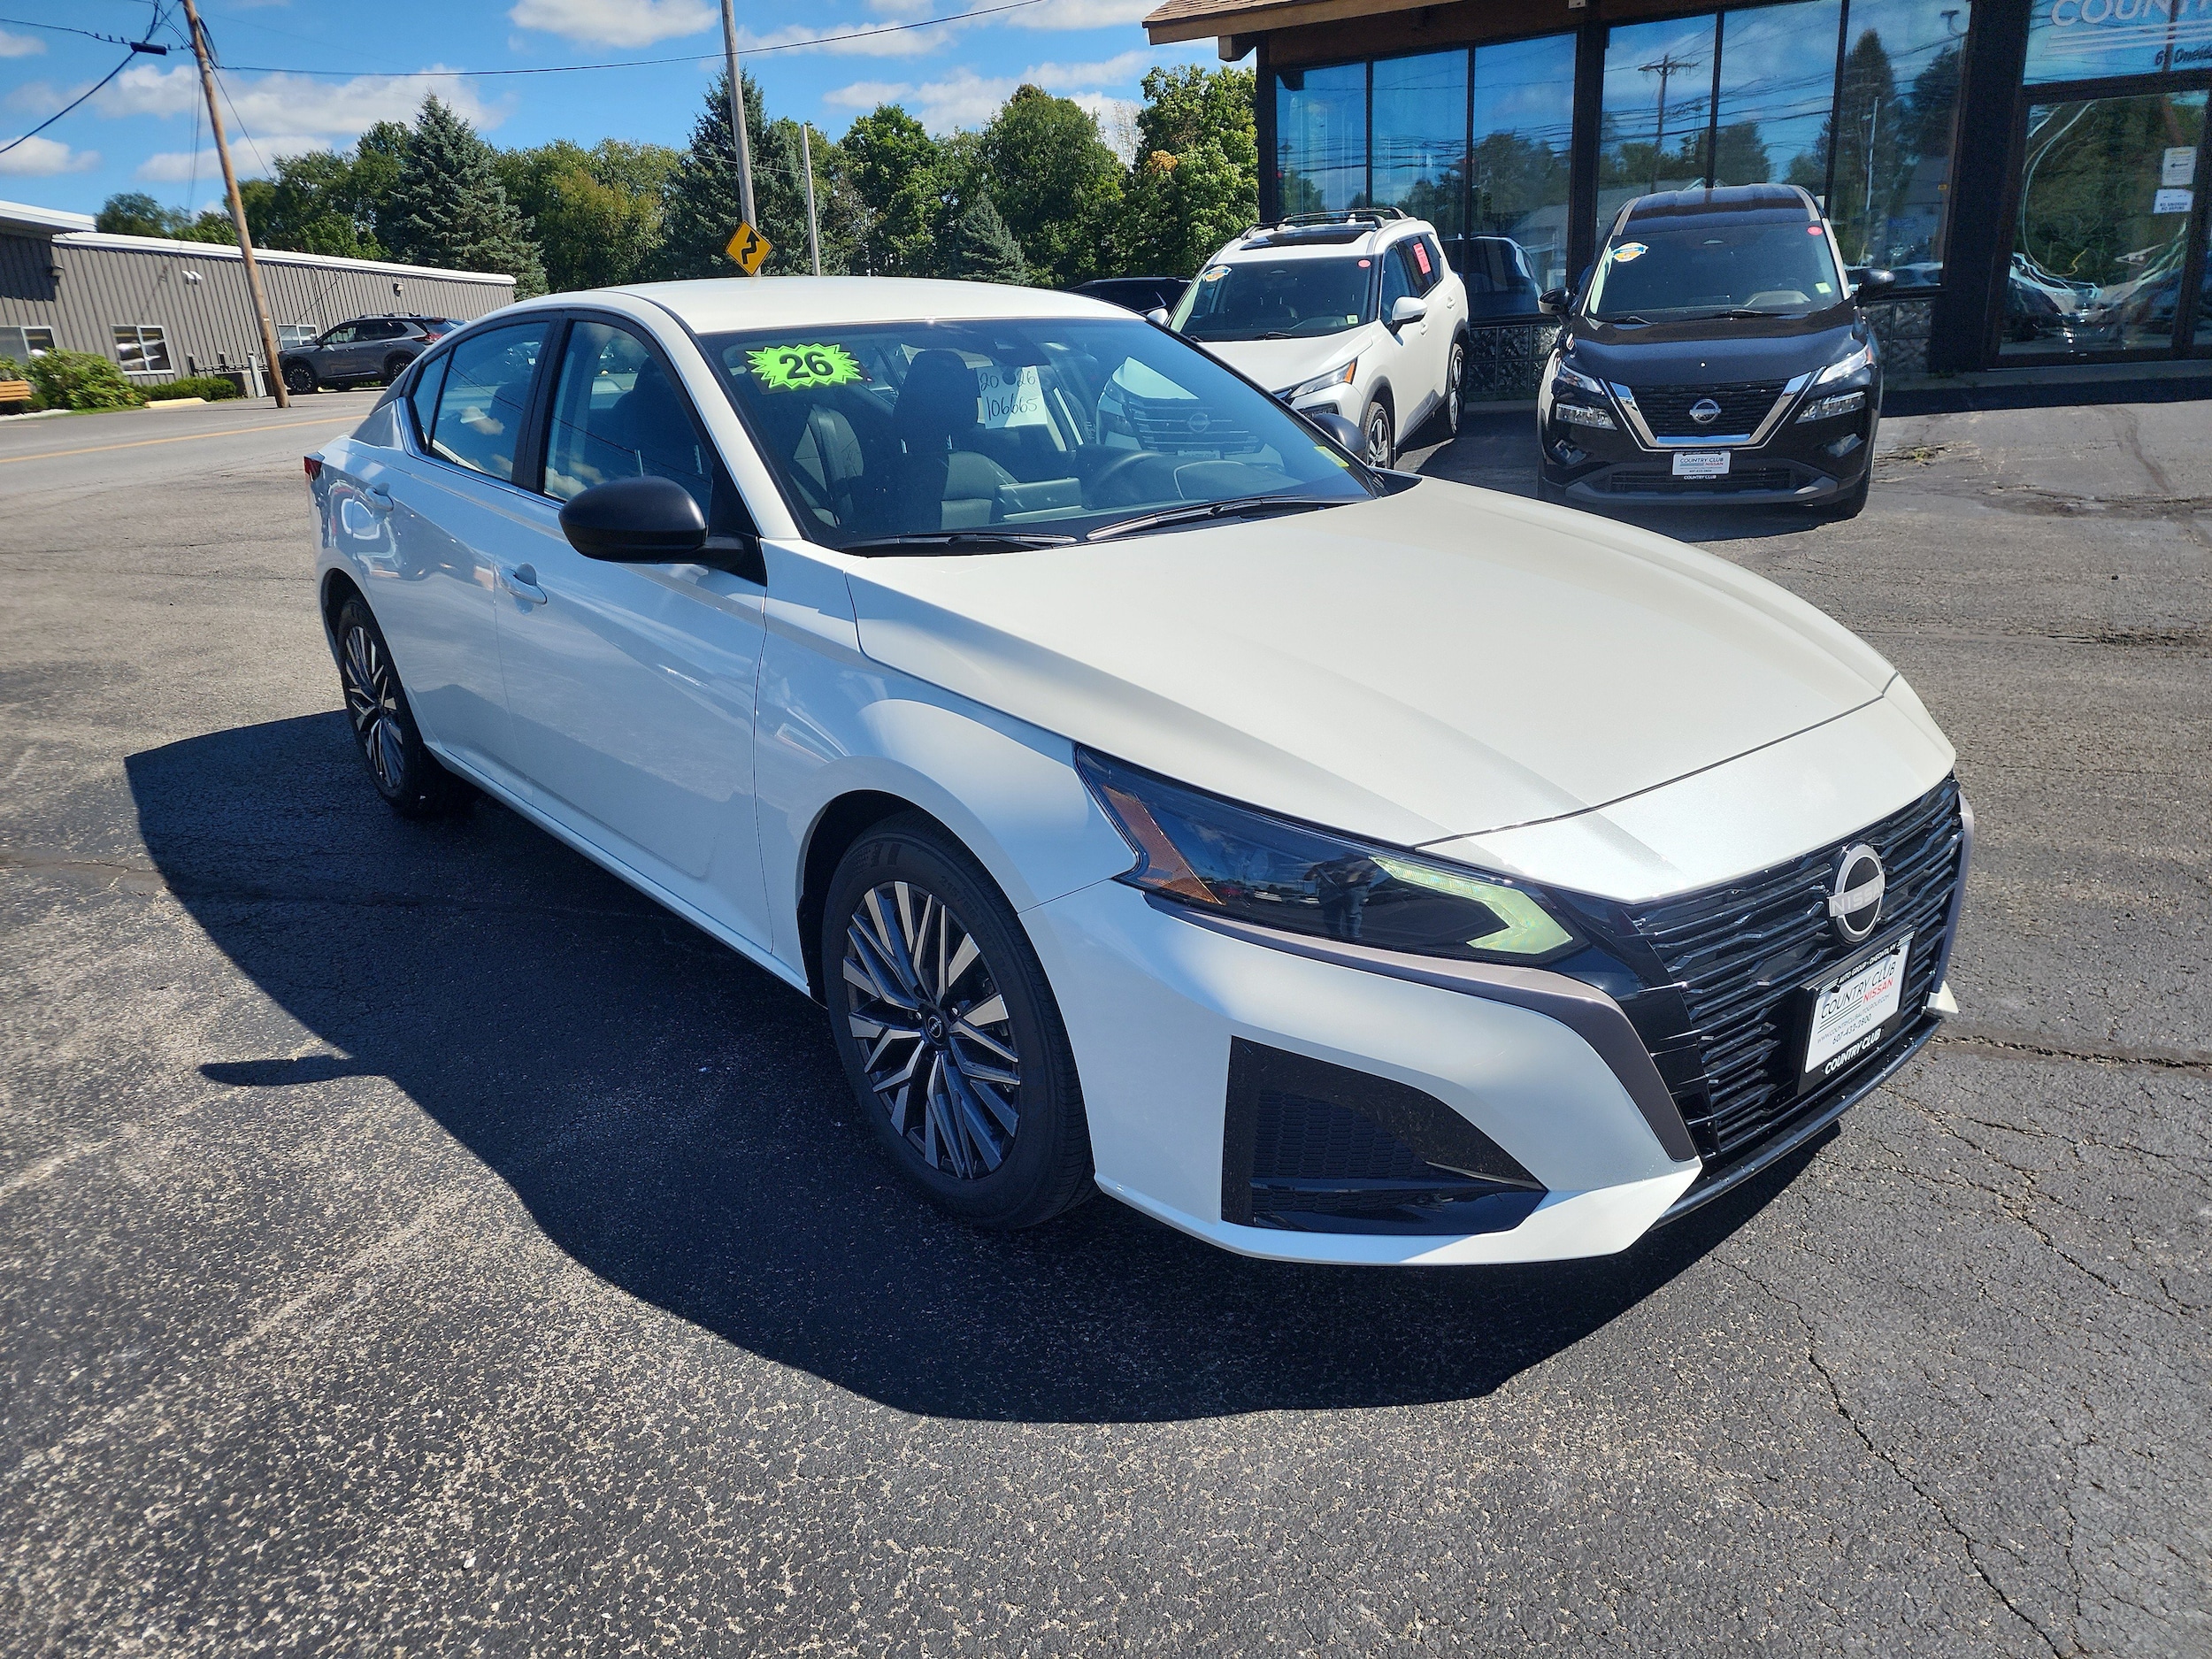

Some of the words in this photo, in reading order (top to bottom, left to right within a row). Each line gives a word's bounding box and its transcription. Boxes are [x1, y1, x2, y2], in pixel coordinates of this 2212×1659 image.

[779, 350, 833, 380] 26
[987, 394, 1038, 421] 106665
[1821, 977, 1870, 1019] COUNTRY
[1871, 961, 1896, 985] CLUB
[1863, 977, 1893, 1004] NISSAN
[1824, 1042, 1862, 1076] COUNTRY
[1862, 1027, 1882, 1055] CLUB
